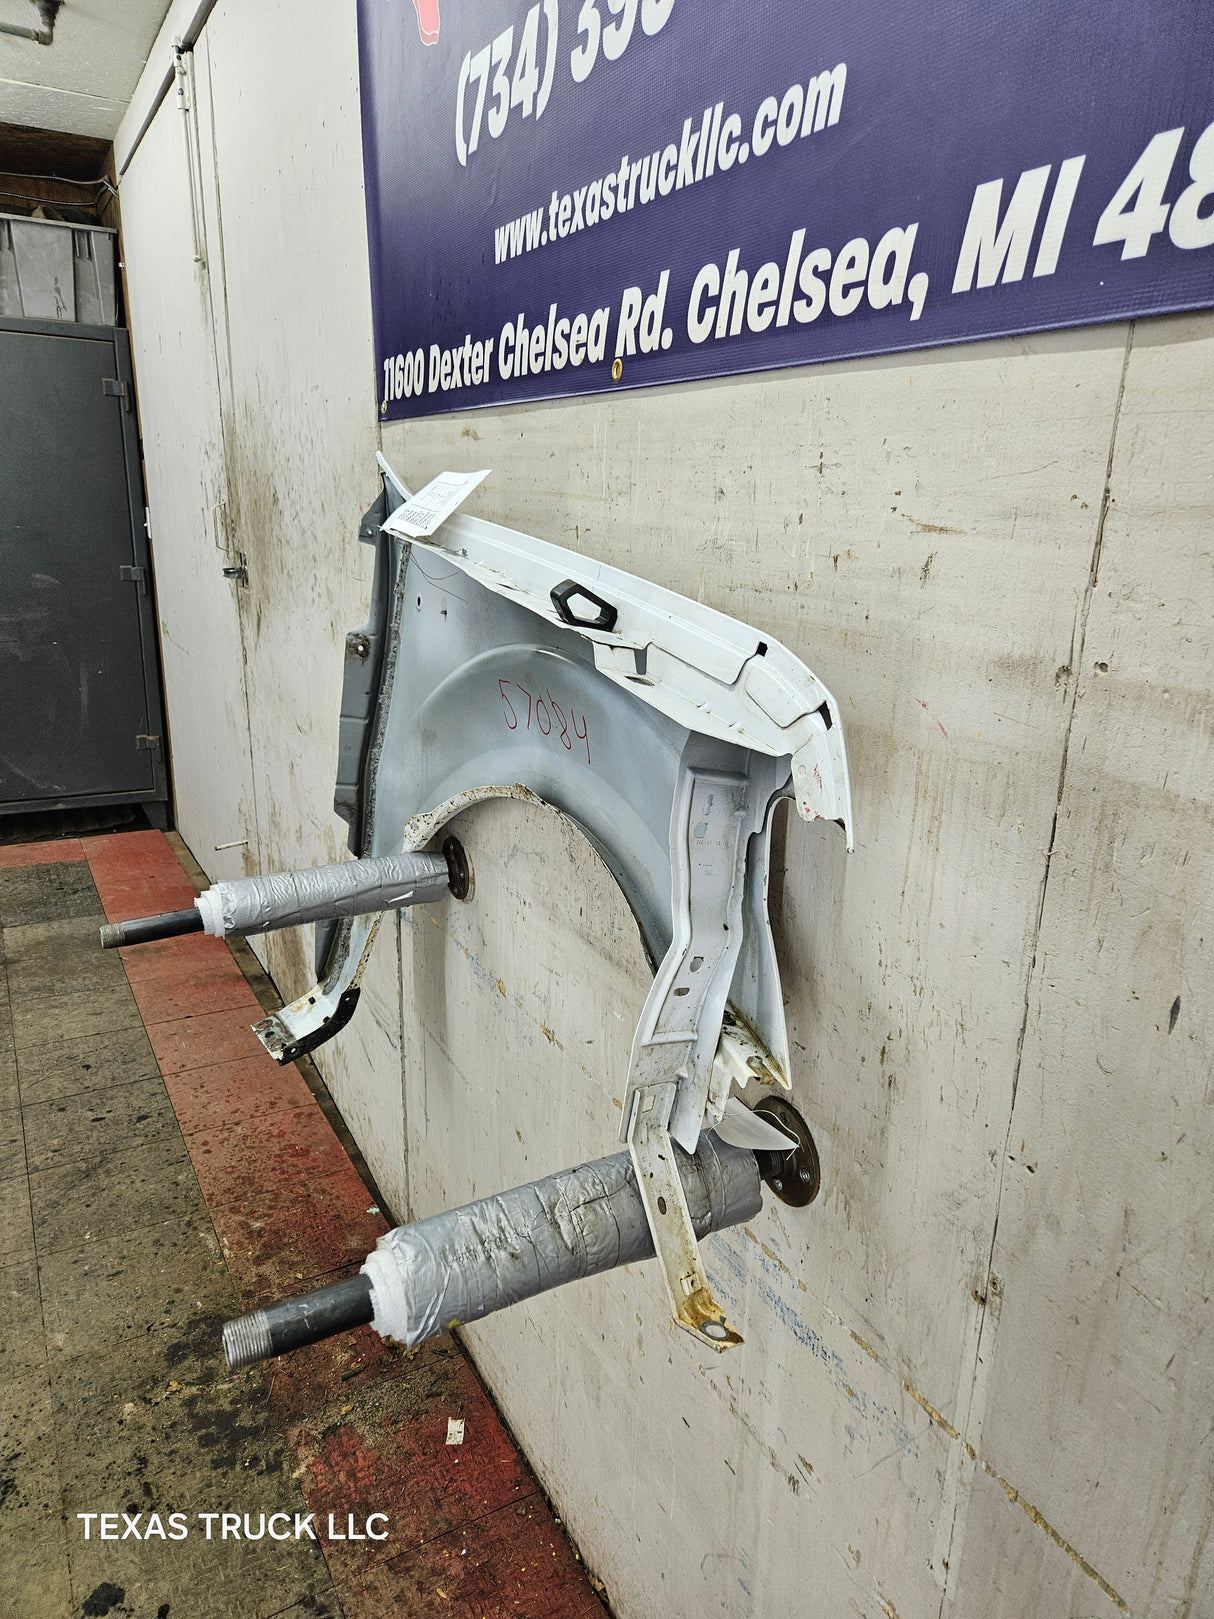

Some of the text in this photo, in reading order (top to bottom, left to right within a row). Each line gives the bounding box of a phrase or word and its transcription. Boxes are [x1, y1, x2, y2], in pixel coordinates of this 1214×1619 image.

[455, 0, 559, 167] (734)
[494, 62, 848, 265] www.texastruckllc.com
[383, 347, 425, 402] 11600
[428, 334, 494, 394] Dexter
[497, 303, 610, 380] Chelsea
[614, 269, 674, 359] Rd.
[686, 222, 930, 344] Chelsea,
[951, 154, 1087, 295] MI
[498, 678, 591, 765] 57084
